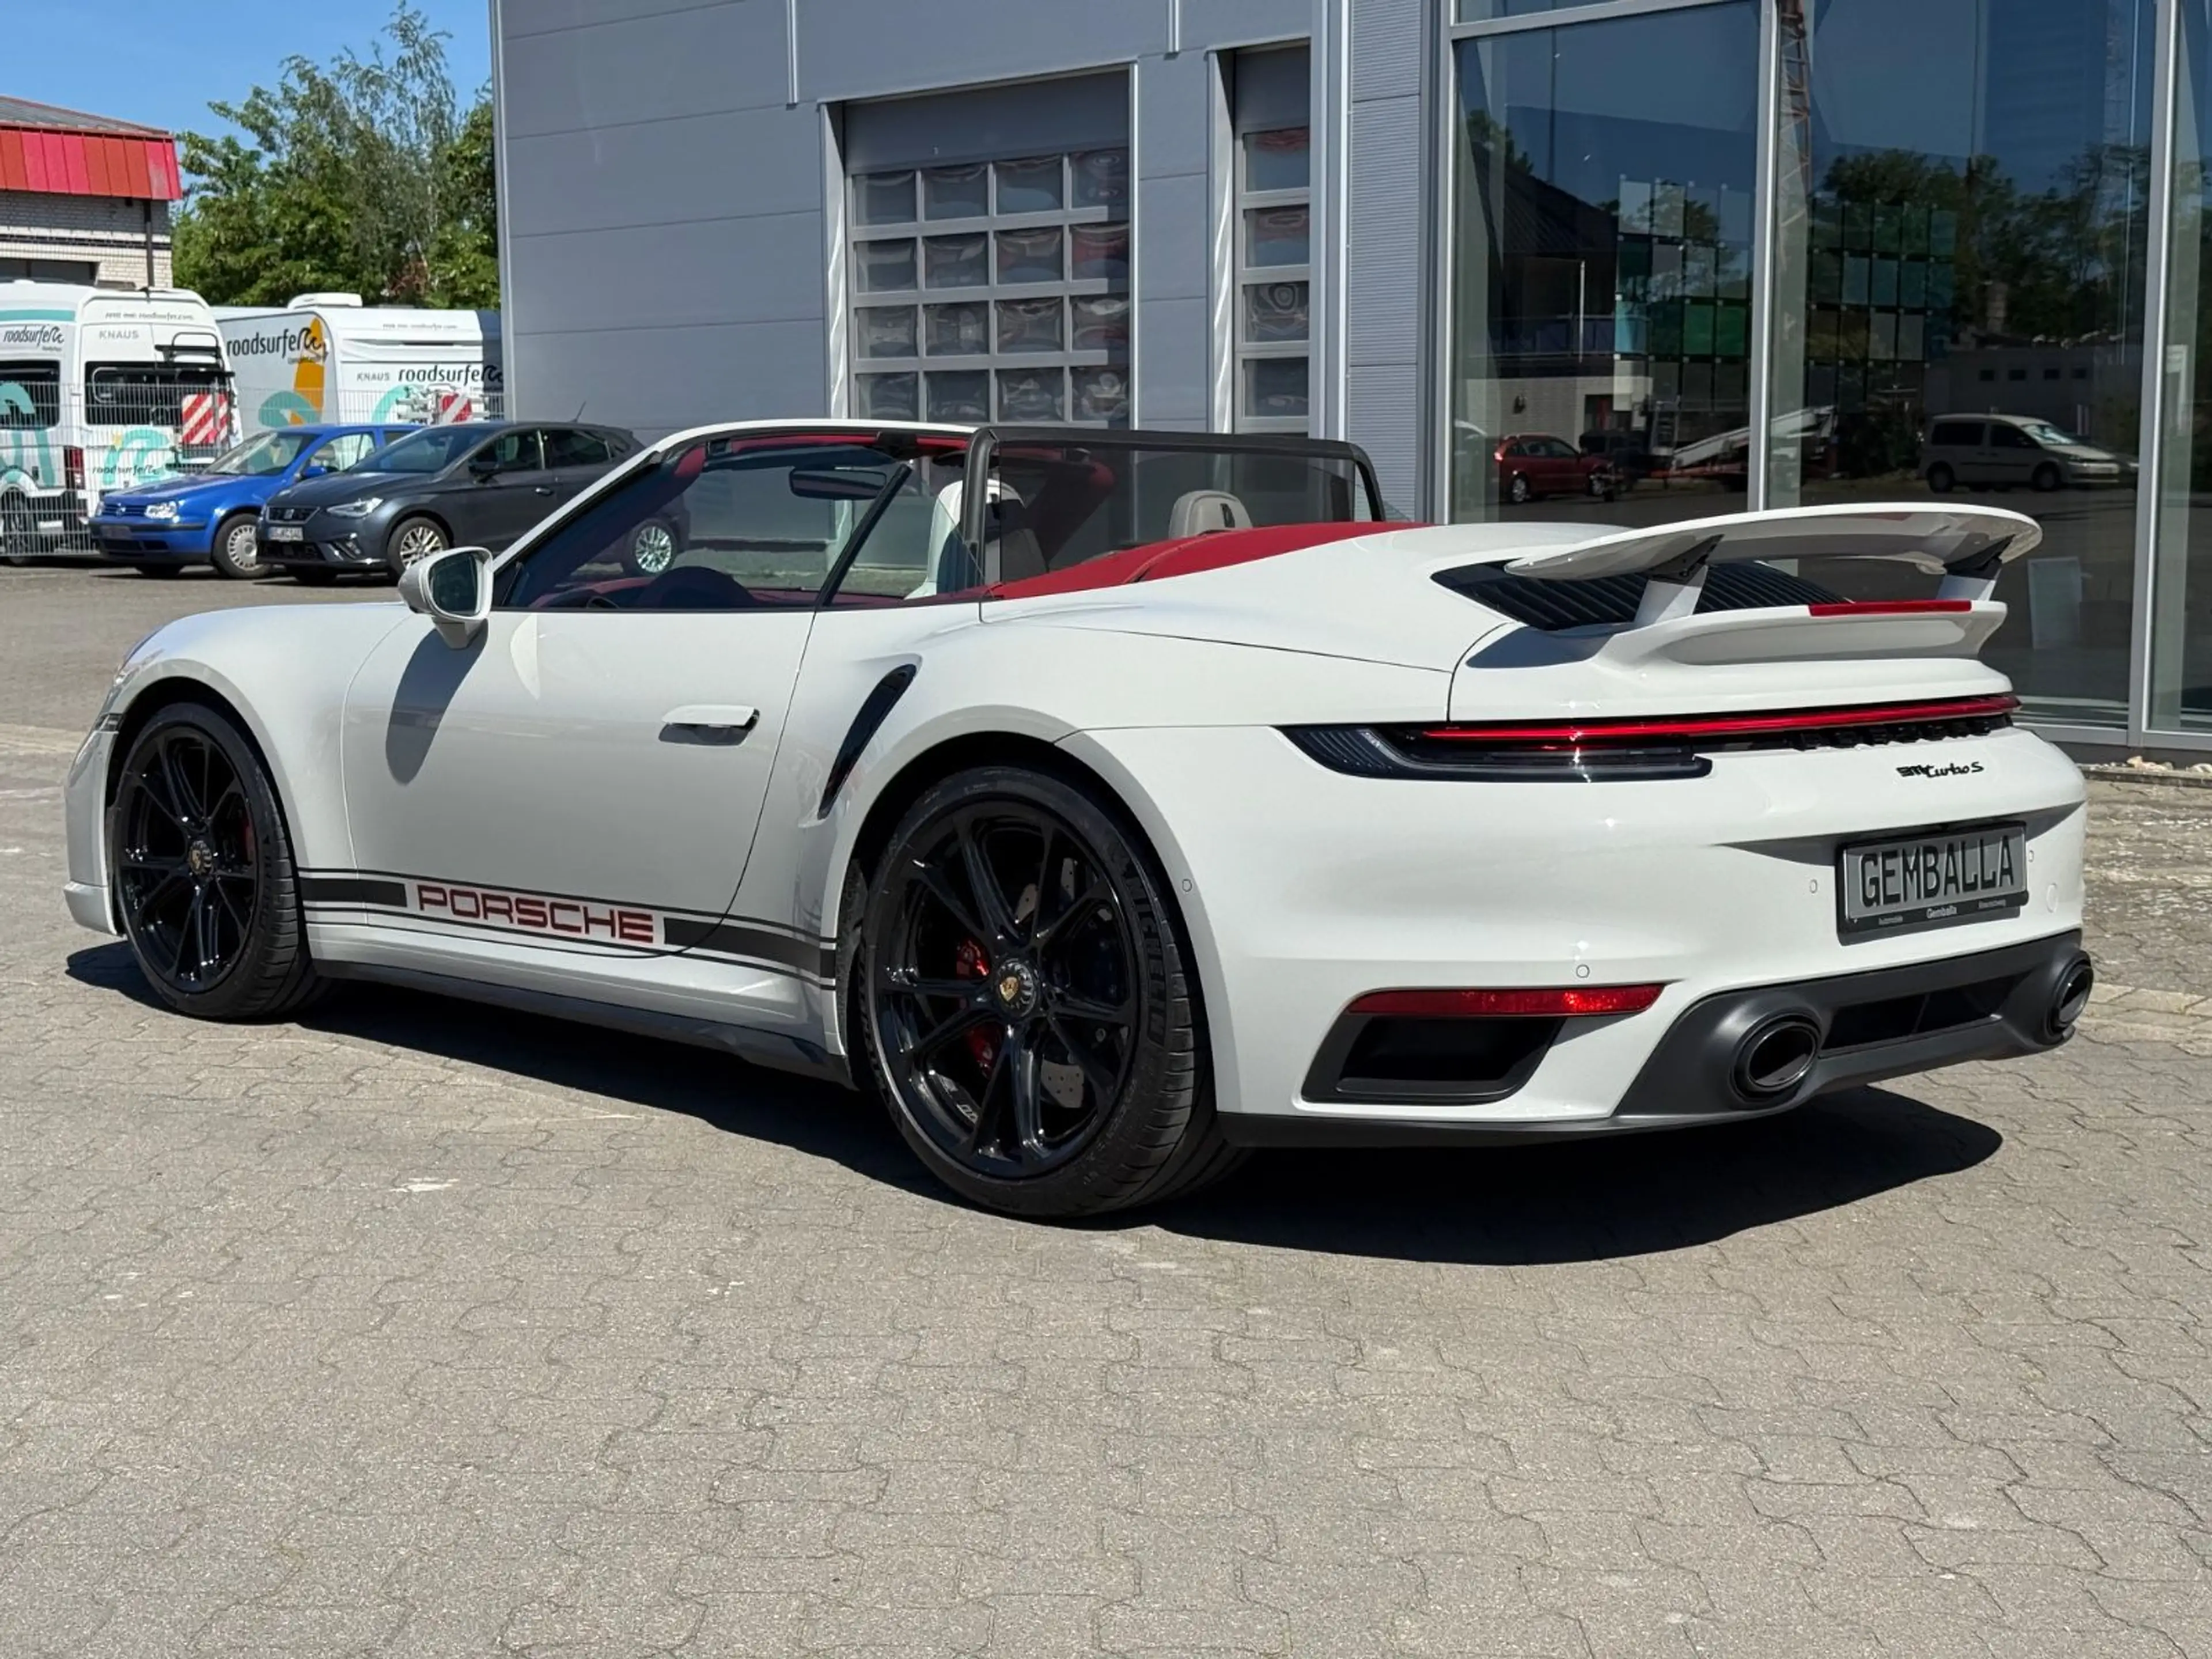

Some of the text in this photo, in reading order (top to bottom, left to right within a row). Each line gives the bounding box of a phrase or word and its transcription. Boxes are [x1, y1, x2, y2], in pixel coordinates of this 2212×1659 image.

[3, 325, 65, 346] roadsurfer
[99, 330, 139, 340] KNAUS
[227, 327, 321, 358] roadsurfer
[357, 372, 389, 381] KNAUS
[398, 365, 503, 386] roadsurfer
[1860, 835, 2014, 908] GEMBALLA
[417, 884, 653, 944] PORSCHE
